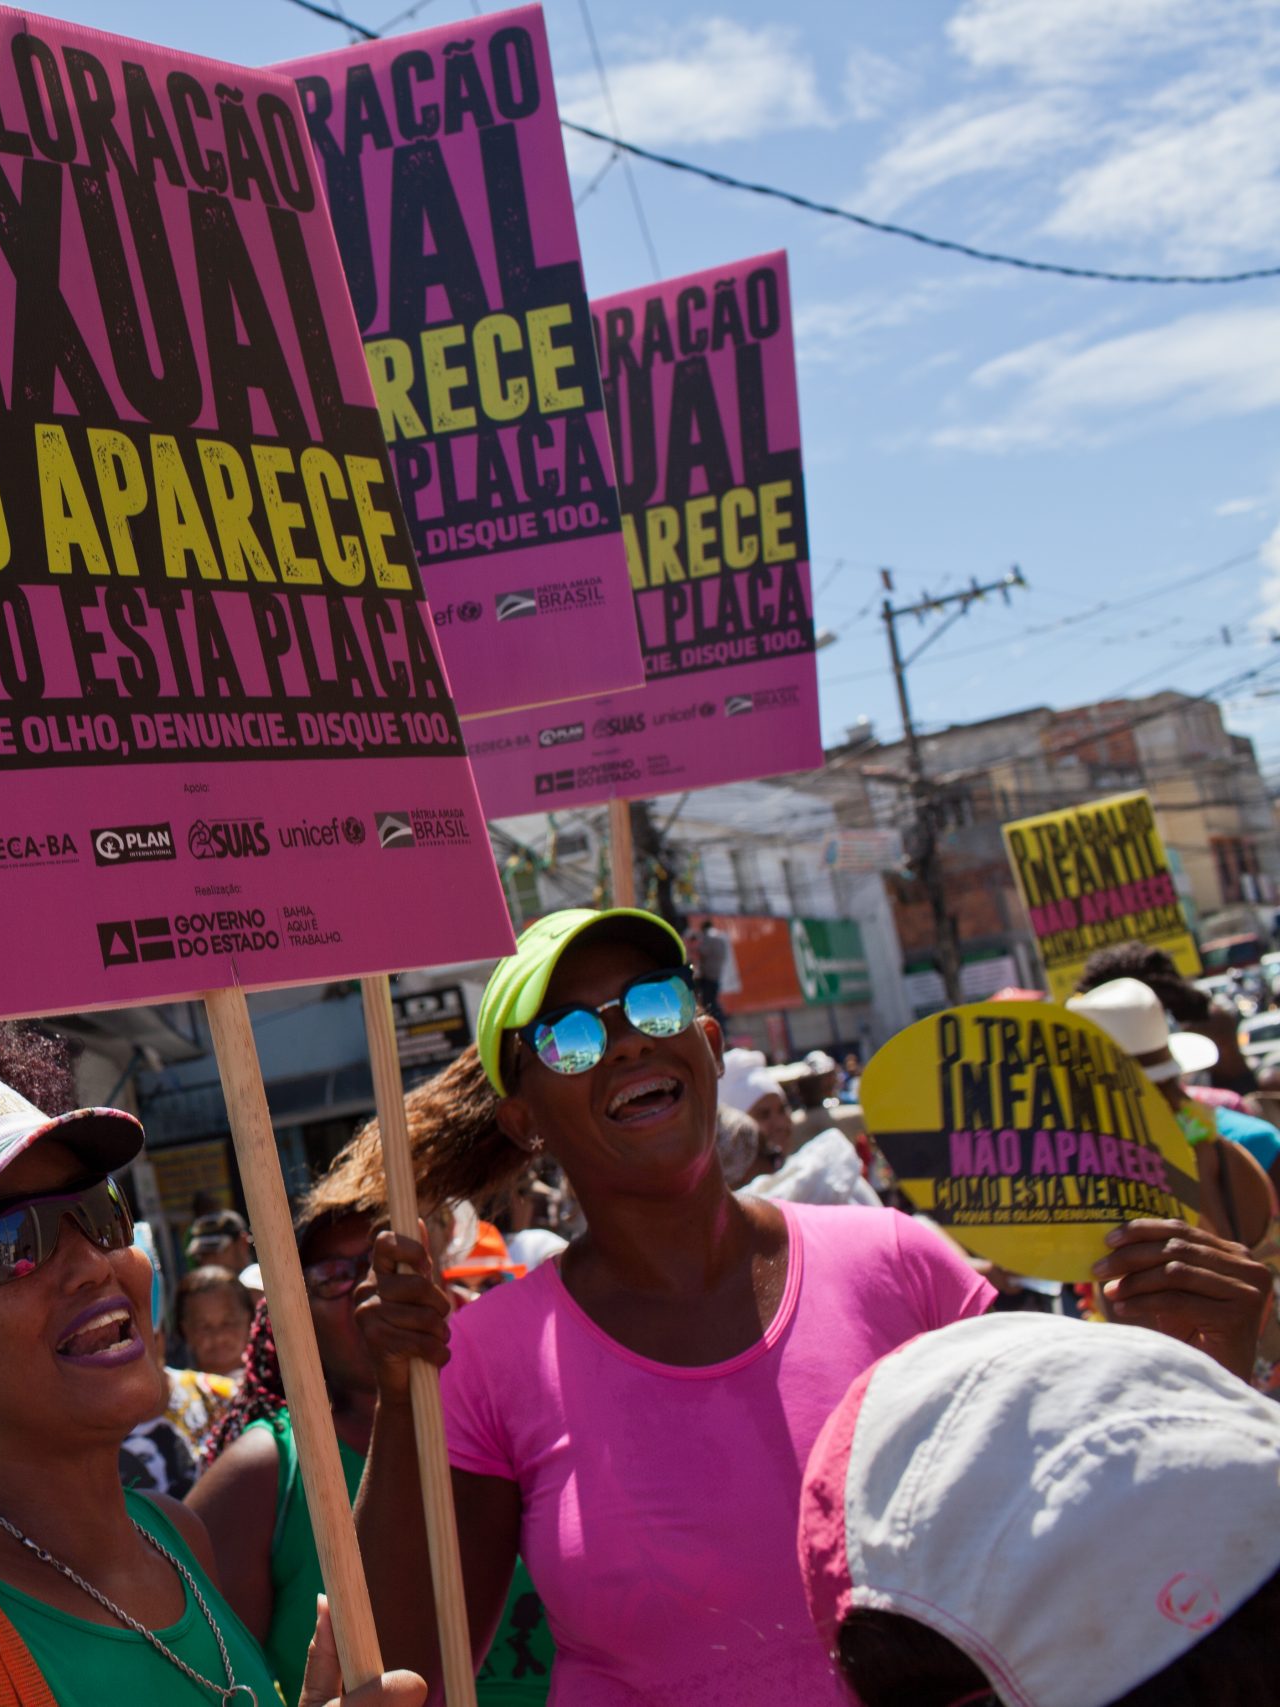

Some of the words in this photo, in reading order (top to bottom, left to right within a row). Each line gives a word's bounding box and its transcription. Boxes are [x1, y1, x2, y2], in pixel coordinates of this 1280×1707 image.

[593, 267, 780, 378] RAÇÃO
[34, 424, 414, 590] APARECE
[426, 512, 539, 554] DISQUE
[542, 500, 608, 534] 100.
[537, 585, 605, 609] BRASIL
[64, 590, 250, 701] ESTA
[260, 596, 449, 700] PLACA
[682, 635, 757, 670] DISQUE
[762, 630, 807, 653] 100.
[653, 704, 696, 727] unicef
[22, 714, 130, 757] OLHO,
[131, 712, 296, 750] DENUNCIE.
[297, 712, 401, 752] DISQUE
[402, 712, 457, 745] 100.
[414, 819, 470, 840] BRASIL
[438, 808, 465, 818] AMADA
[126, 831, 170, 849] PLAN
[211, 822, 270, 859] SUAS
[278, 819, 340, 848] unicef
[174, 909, 266, 935] GOVERNO
[287, 920, 310, 933] AQUI
[178, 937, 208, 958] DO
[211, 930, 280, 954] ESTADO
[938, 1014, 962, 1062] O
[949, 1128, 1021, 1178] NÃO
[1032, 1130, 1172, 1193] APARECE
